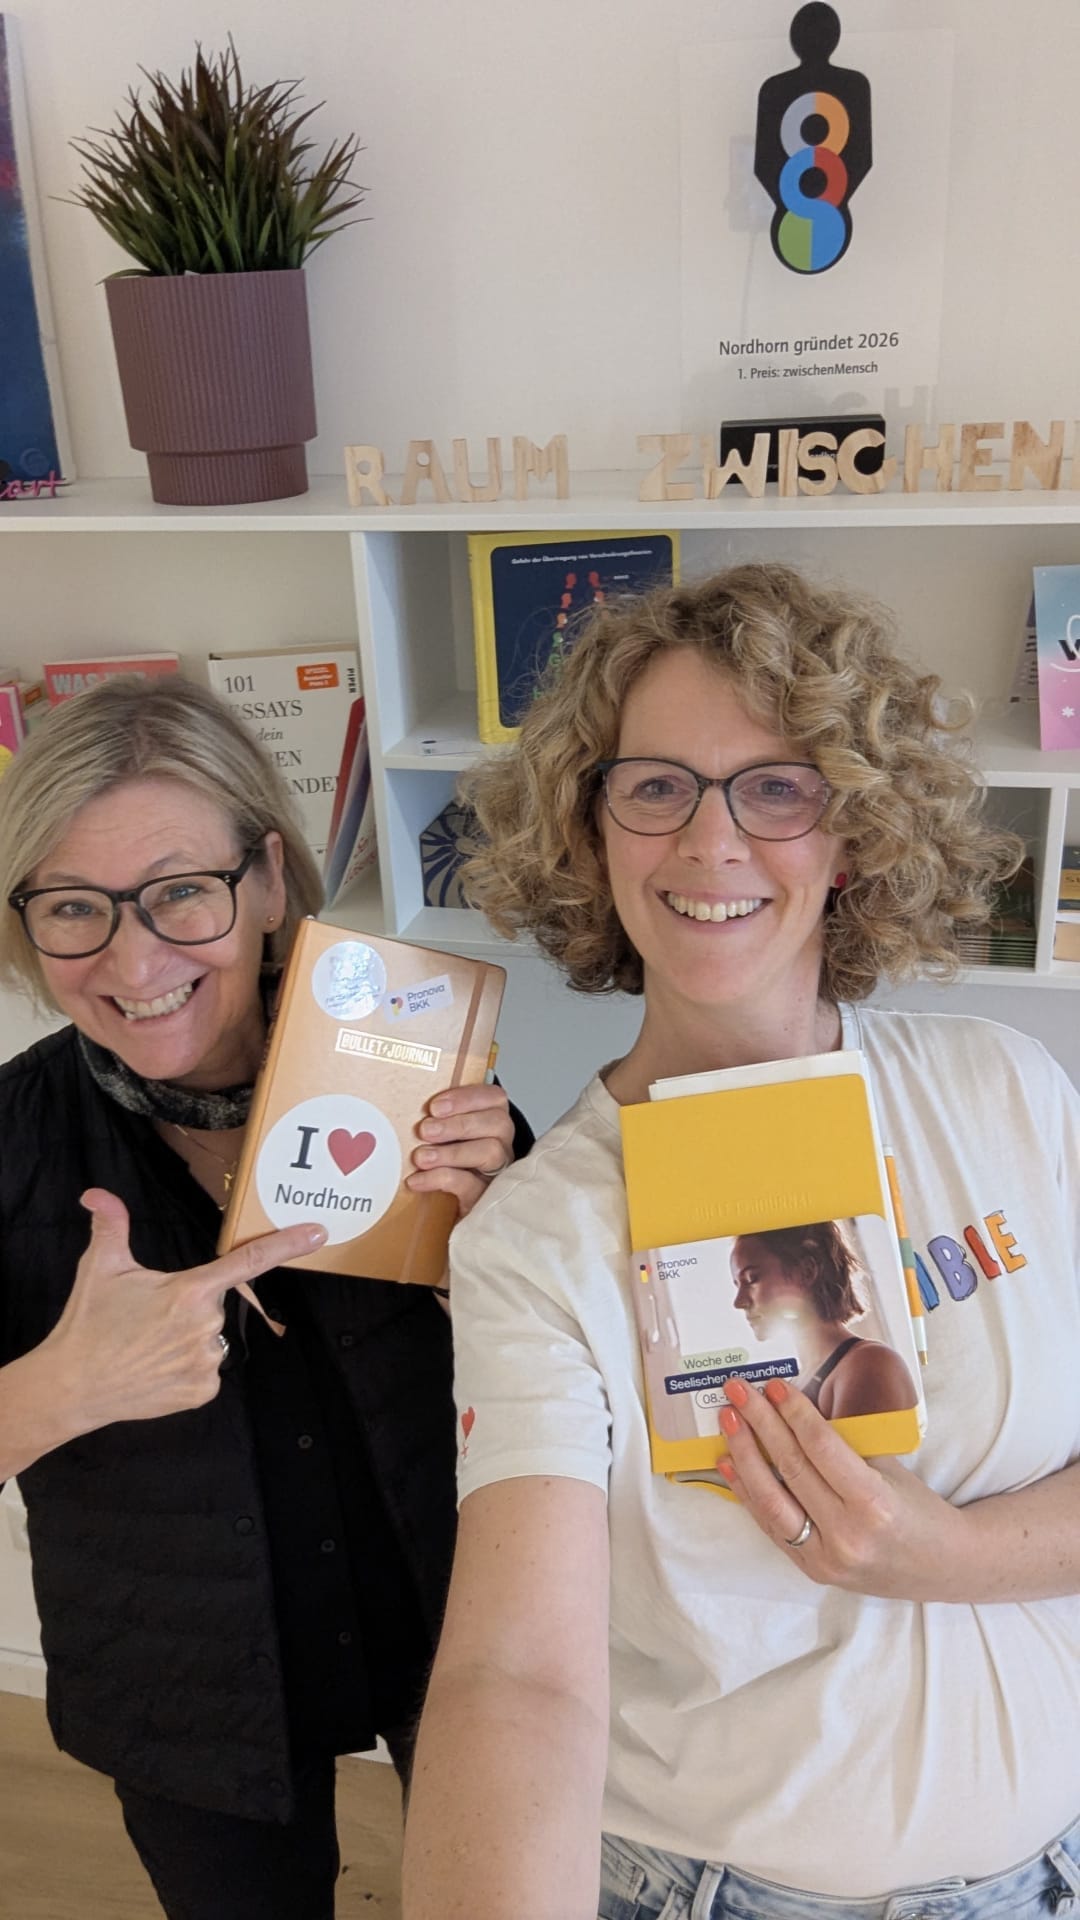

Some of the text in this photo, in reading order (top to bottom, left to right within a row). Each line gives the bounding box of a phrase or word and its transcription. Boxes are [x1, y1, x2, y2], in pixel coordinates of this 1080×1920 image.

[719, 332, 899, 356] Nordhorn gründet 2026
[737, 361, 878, 380] 1. Preis: zwischenMensch
[343, 420, 1080, 507] RAUM ZWISCHEN
[224, 675, 256, 694] 101
[256, 727, 284, 741] dein
[407, 983, 446, 1003] Pronova
[409, 1000, 431, 1013] BKK
[290, 1125, 320, 1170] I
[274, 1183, 373, 1214] Nordhorn
[656, 1257, 698, 1271] Pronova
[658, 1269, 681, 1281] BKK
[683, 1352, 744, 1370] Woche der
[669, 1363, 794, 1391] Seelischen Gesundheit
[702, 1391, 728, 1405] 08.-
